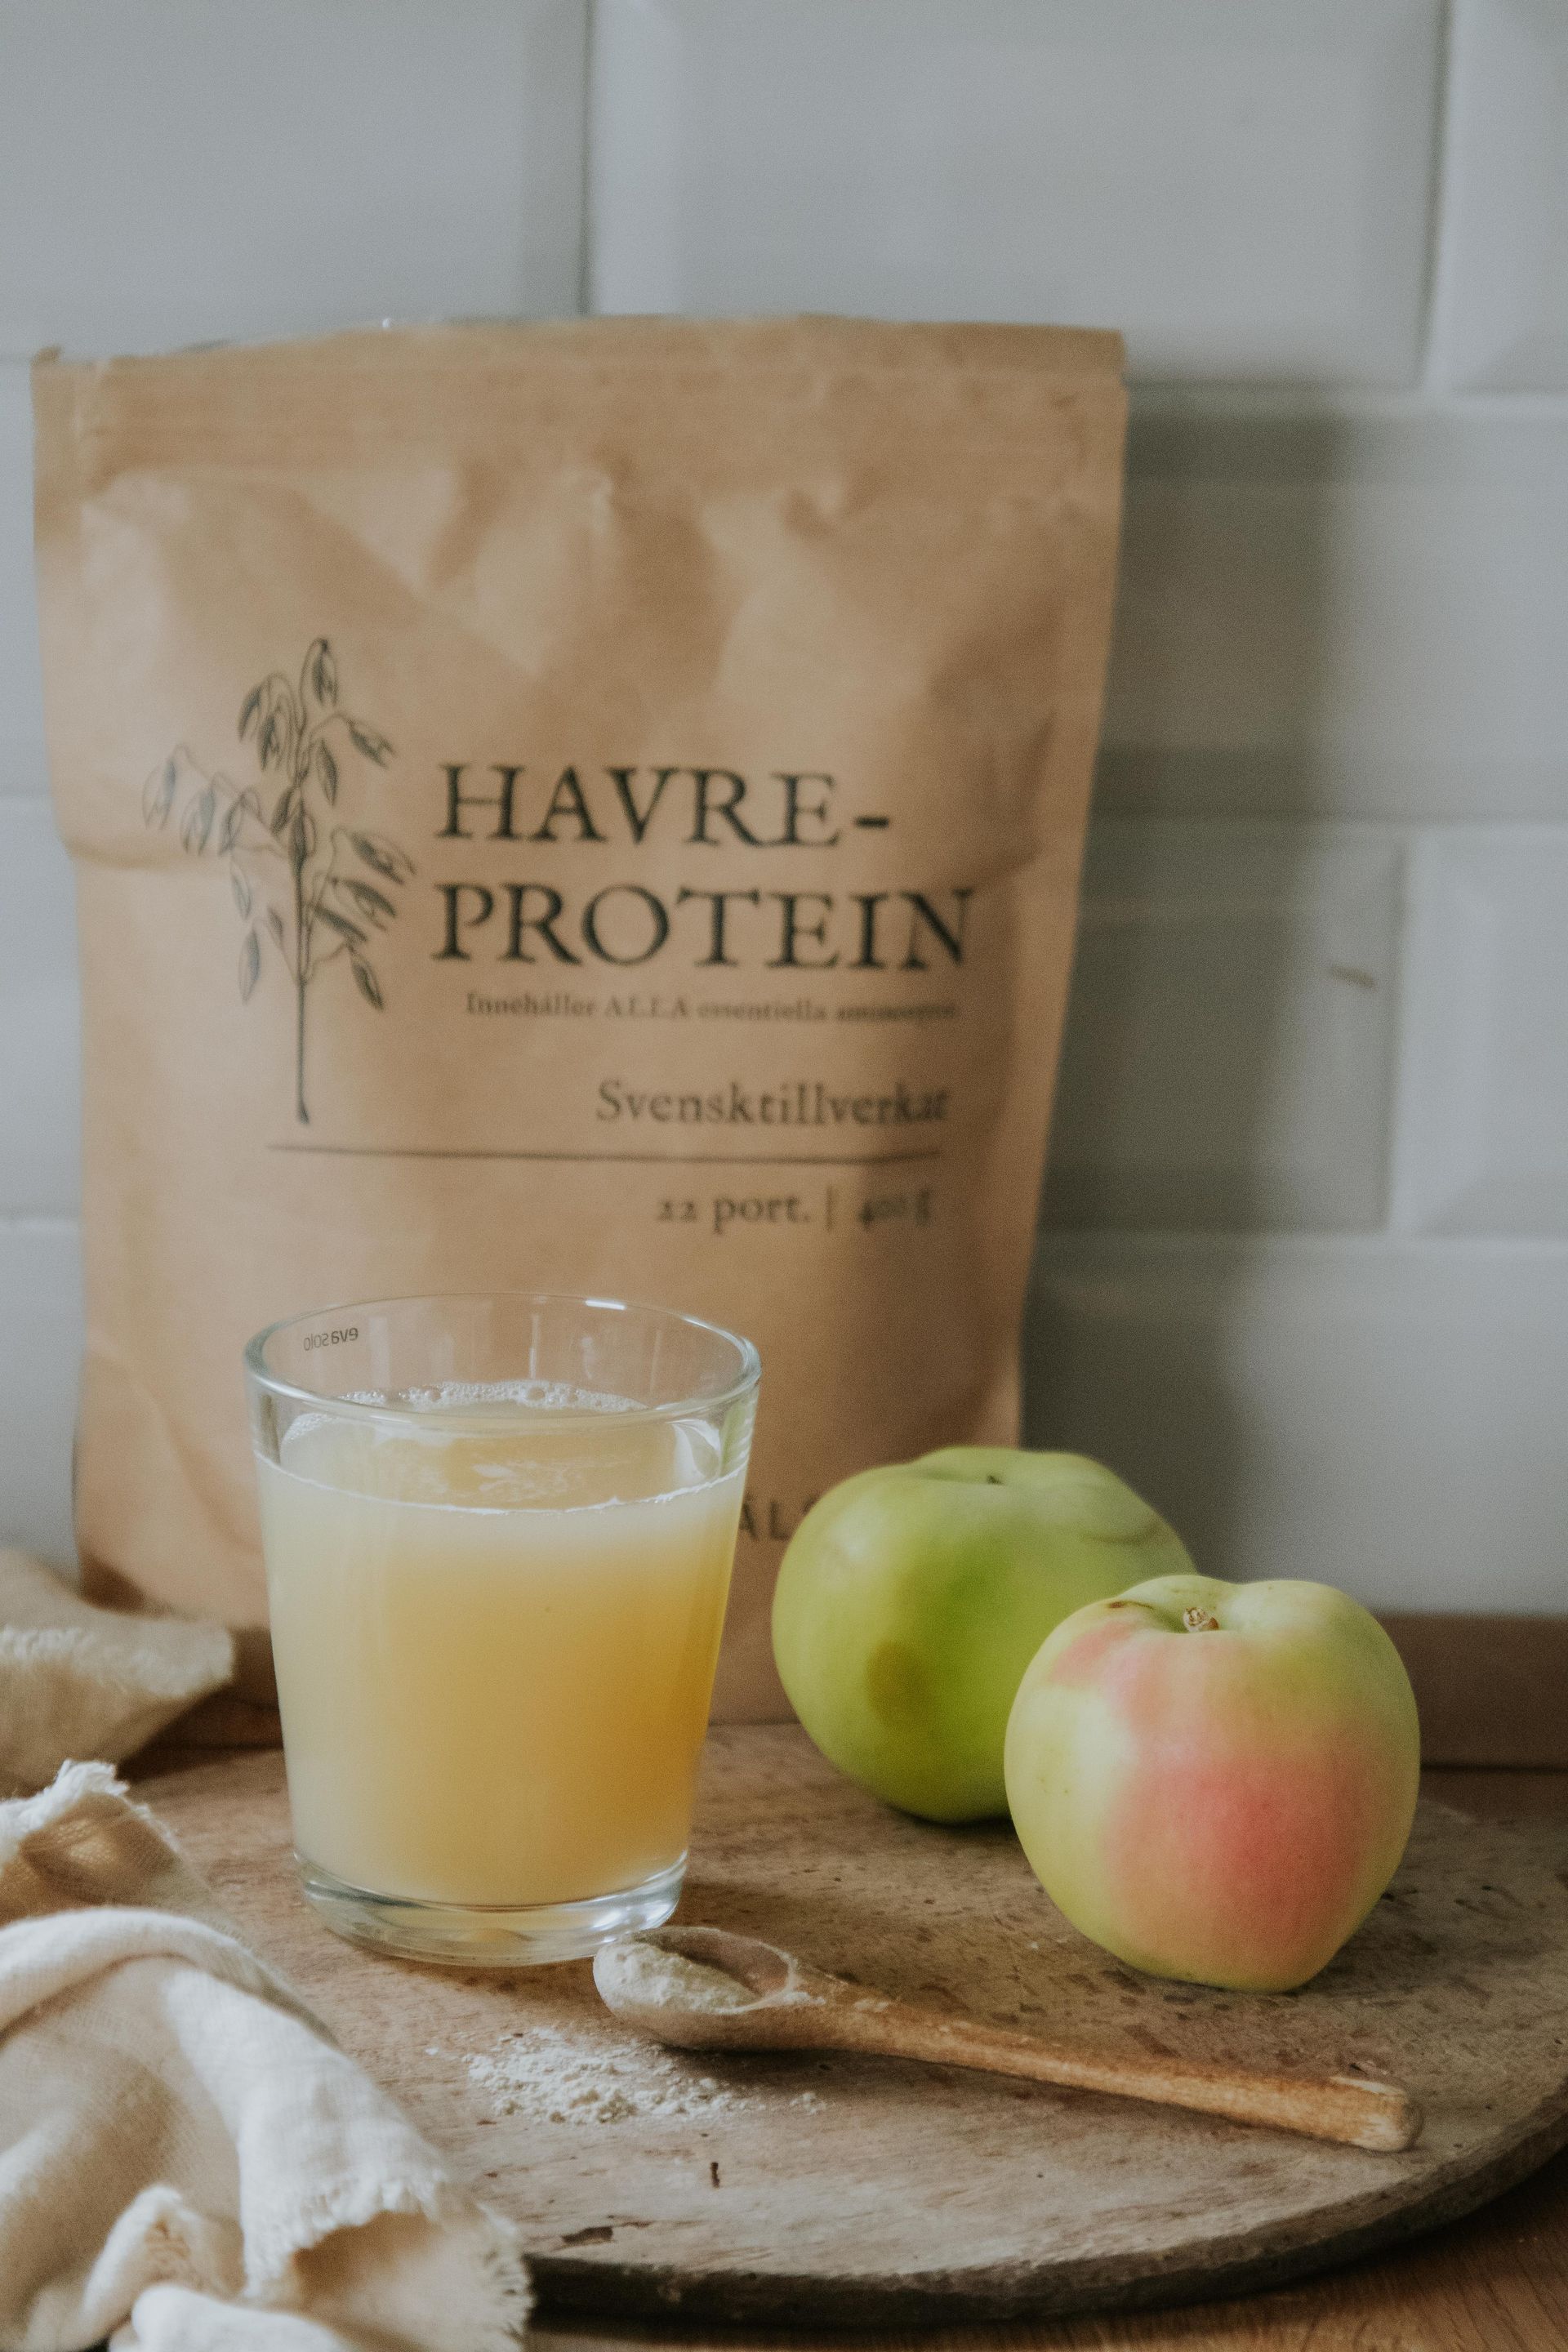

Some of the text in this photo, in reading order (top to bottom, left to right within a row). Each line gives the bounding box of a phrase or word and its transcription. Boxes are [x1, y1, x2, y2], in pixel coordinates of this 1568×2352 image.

[434, 763, 890, 849] HAVRE-
[431, 881, 975, 973] PROTEIN
[604, 993, 689, 1020] ALLA
[595, 1076, 952, 1127] Svensktillverkat
[657, 1198, 698, 1223] 22
[711, 1188, 811, 1236] port.
